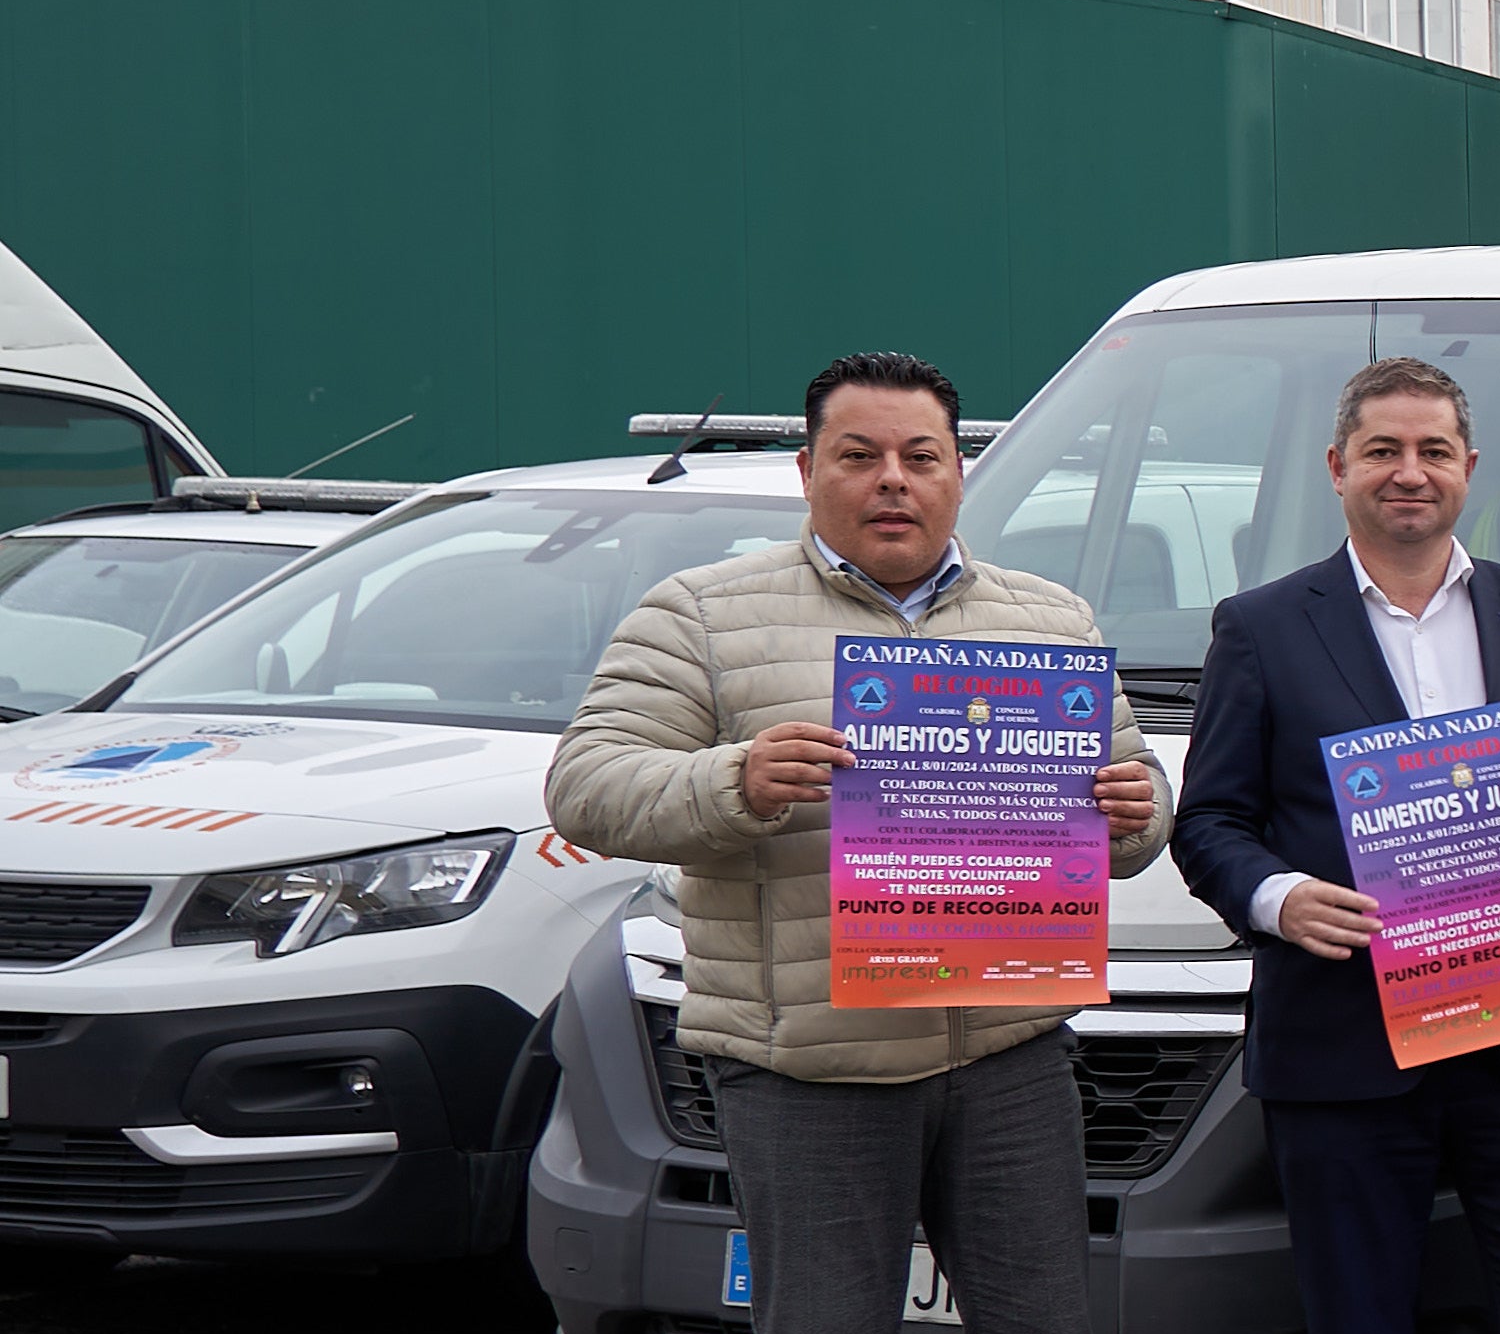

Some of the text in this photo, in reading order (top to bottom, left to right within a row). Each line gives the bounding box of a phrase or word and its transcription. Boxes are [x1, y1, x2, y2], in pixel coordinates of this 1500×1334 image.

[842, 643, 1106, 673] CAMPAÑA NADAL 2023
[912, 673, 1044, 697] RECOGIDA
[841, 723, 1102, 758] ALIMENTOS Y JUGUETES
[1330, 721, 1444, 759] CAMPAÑA
[1347, 792, 1463, 838] ALIMENTOS
[1464, 788, 1482, 815] Y
[838, 900, 1098, 915] PUNTO DE RECOGIDA AQUI
[734, 1275, 746, 1291] E
